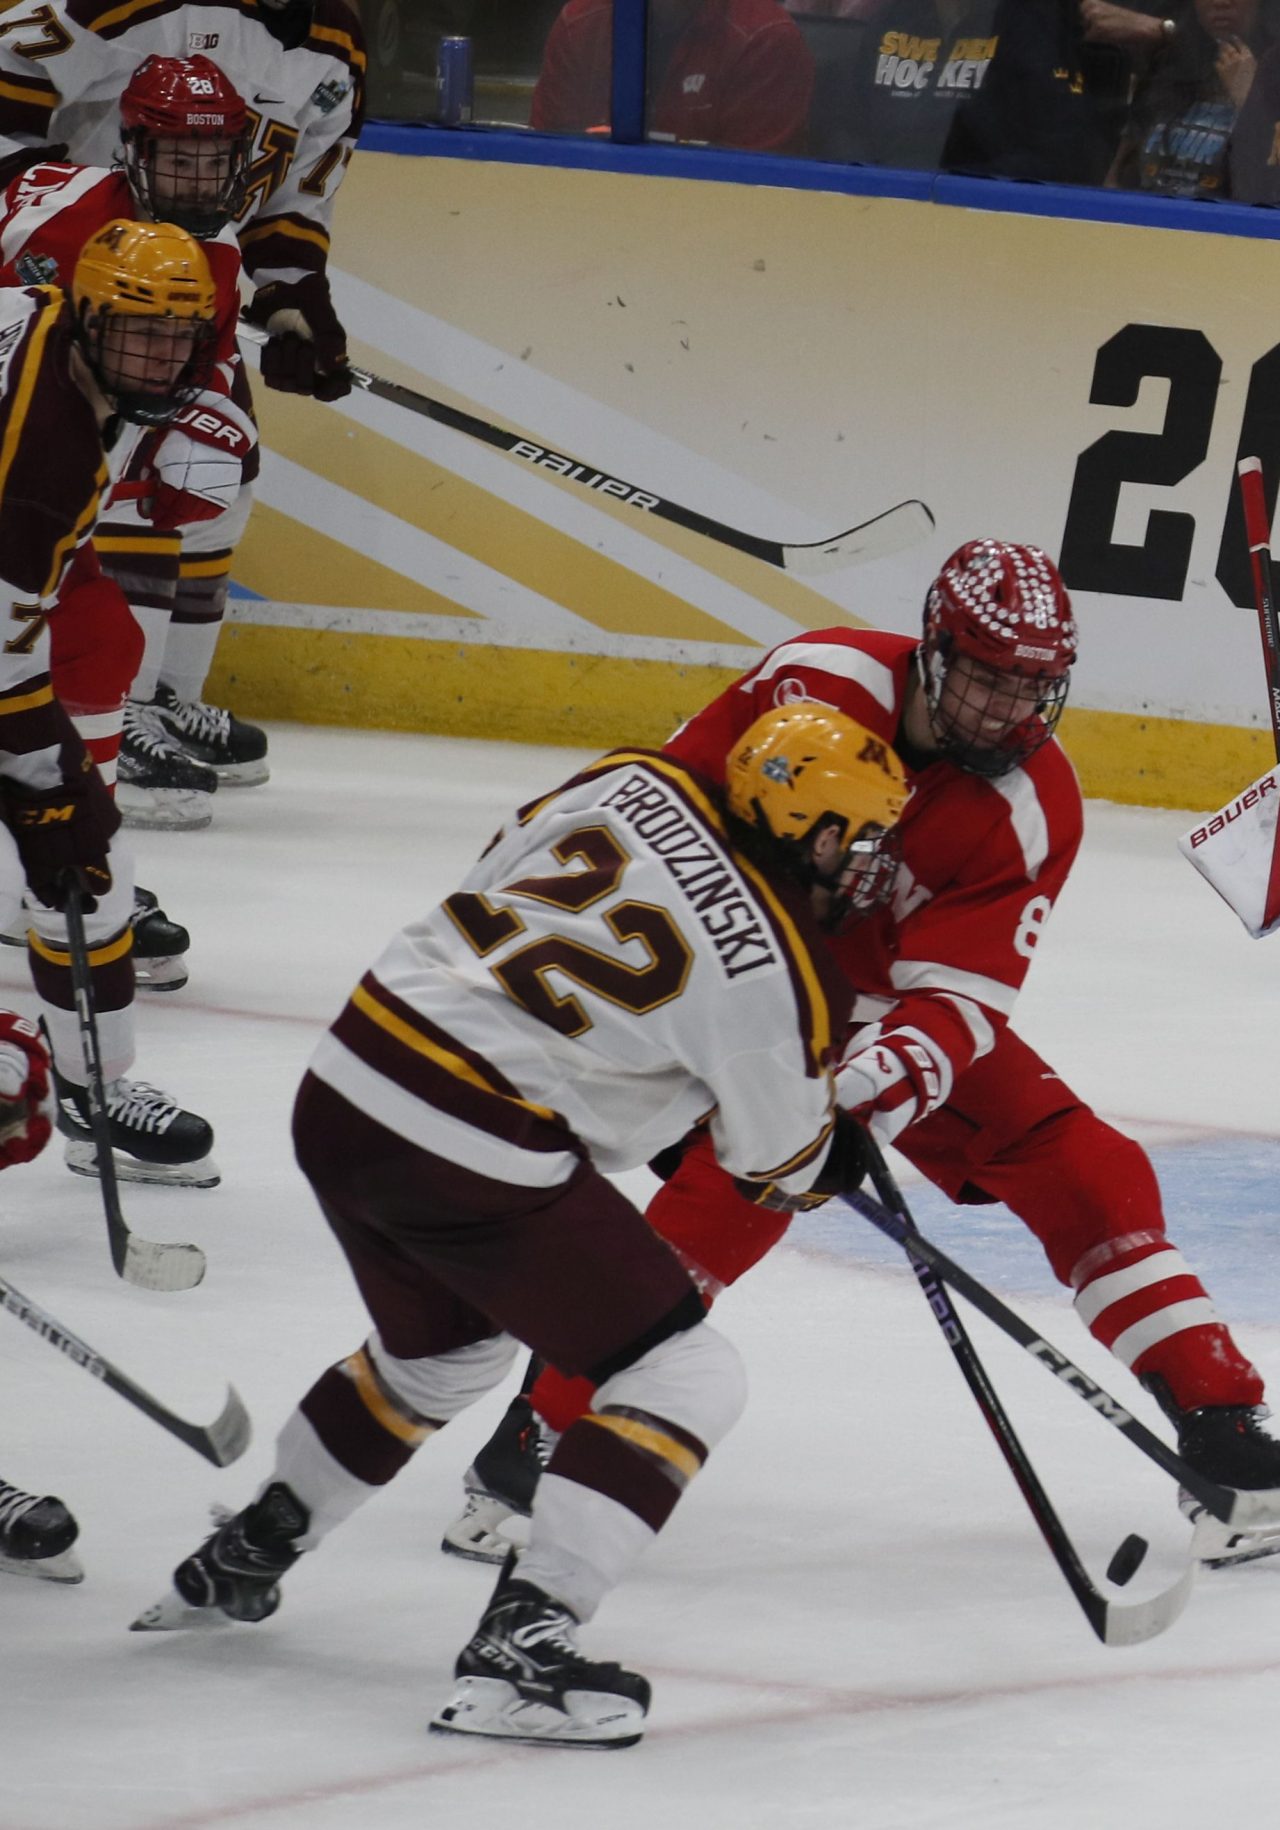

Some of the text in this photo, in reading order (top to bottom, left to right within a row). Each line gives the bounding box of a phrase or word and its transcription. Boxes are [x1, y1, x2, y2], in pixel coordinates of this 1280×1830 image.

[186, 114, 224, 125] BOSTON
[189, 80, 214, 94] 28
[508, 440, 661, 512] BAUER
[1014, 644, 1057, 661] BOSTON
[1189, 775, 1278, 850] BAUER
[441, 824, 696, 1039] 22
[1026, 1338, 1131, 1426] CCM
